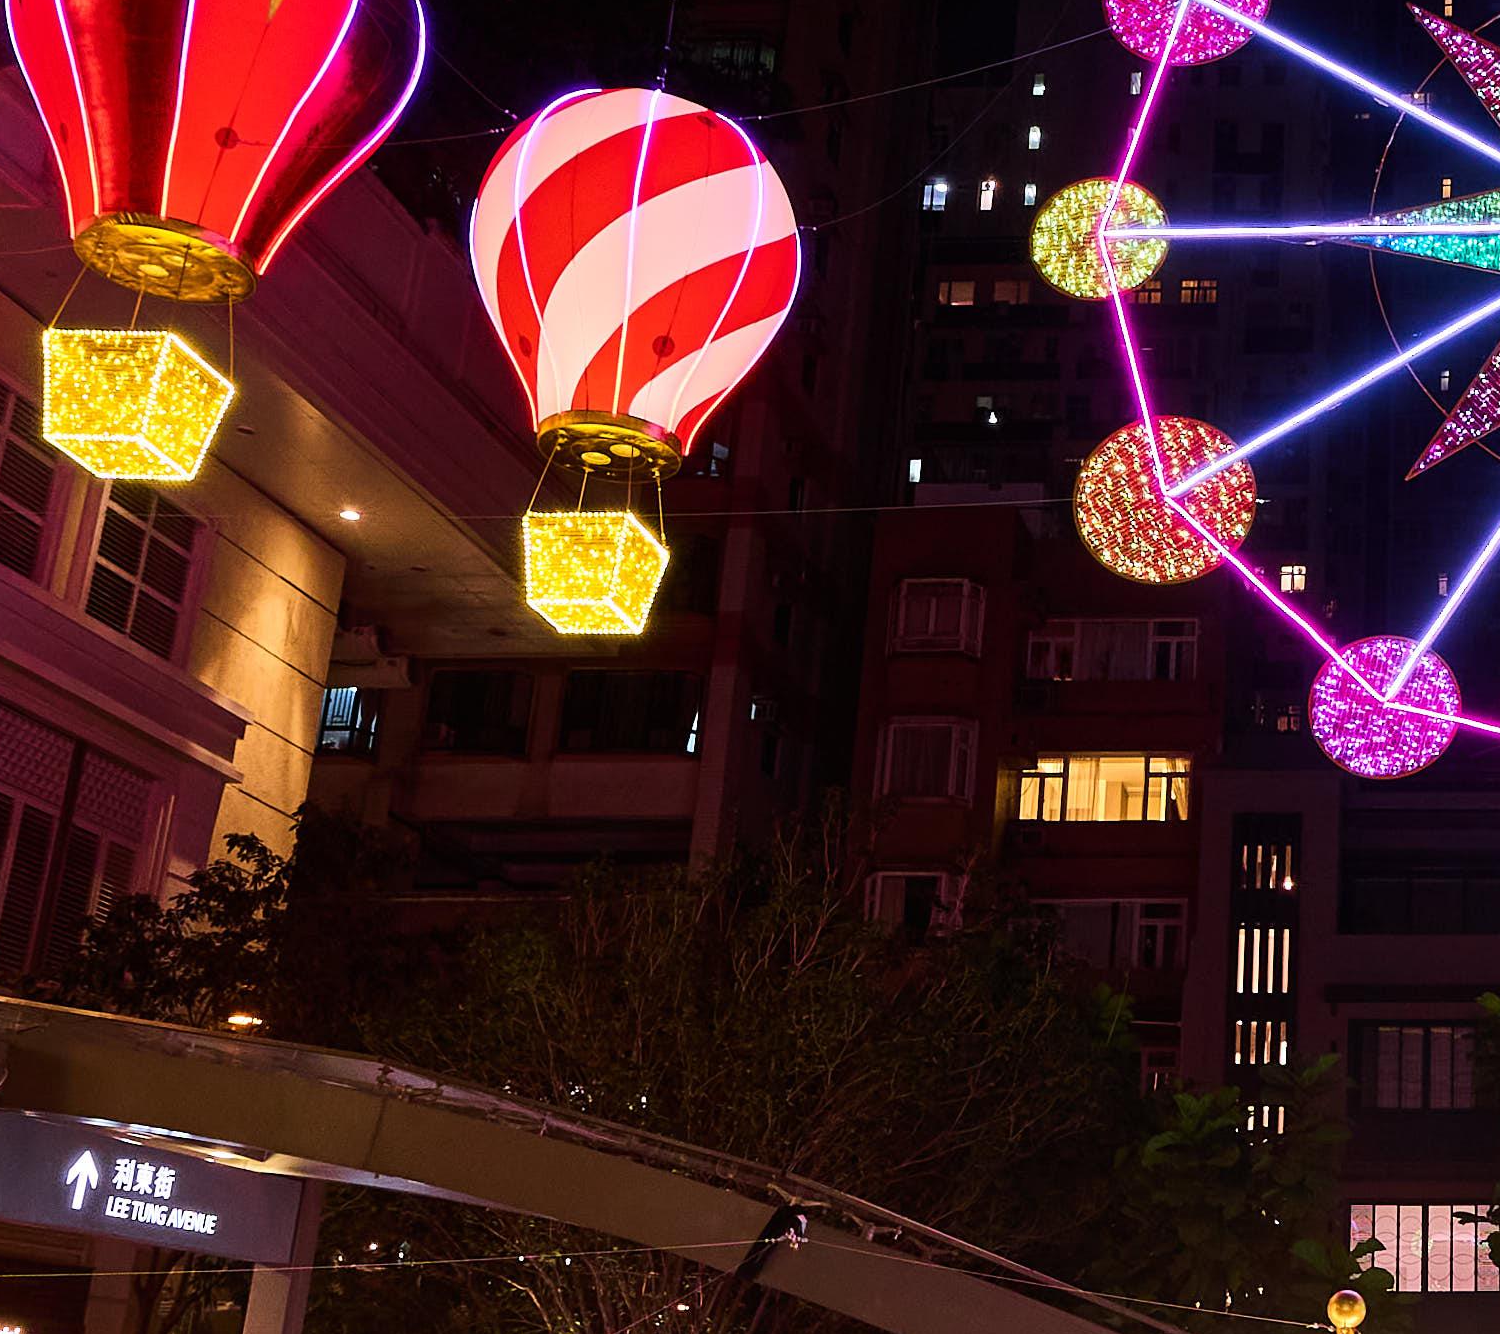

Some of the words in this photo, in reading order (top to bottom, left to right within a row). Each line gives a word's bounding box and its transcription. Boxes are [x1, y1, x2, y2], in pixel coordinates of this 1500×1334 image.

[112, 1158, 176, 1200] 利東街
[105, 1195, 132, 1219] LEE
[131, 1200, 169, 1227] TUNG
[166, 1207, 218, 1235] AVENUE
